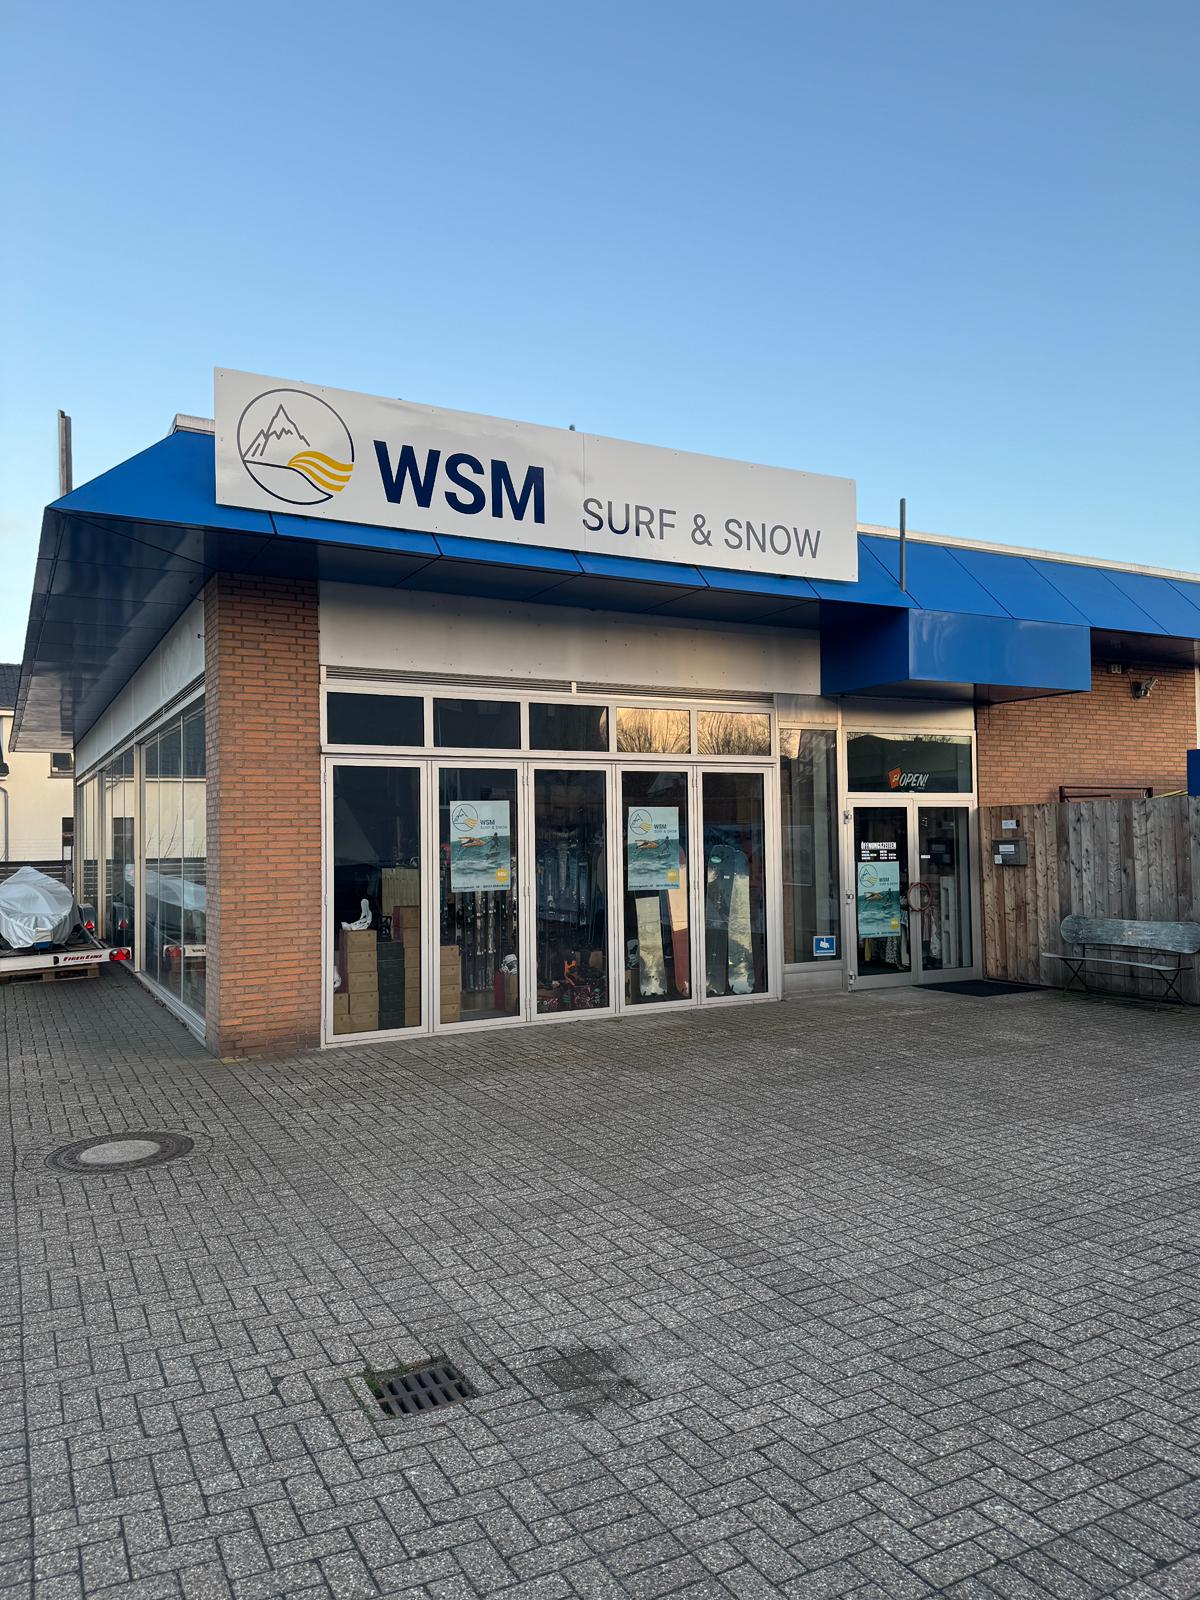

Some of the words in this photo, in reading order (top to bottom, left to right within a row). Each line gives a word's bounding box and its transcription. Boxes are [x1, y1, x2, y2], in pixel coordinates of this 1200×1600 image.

[373, 440, 546, 525] WSM
[582, 497, 677, 541] SURF
[690, 513, 713, 546] &
[723, 518, 822, 559] SNOW
[899, 772, 930, 787] OPEN!
